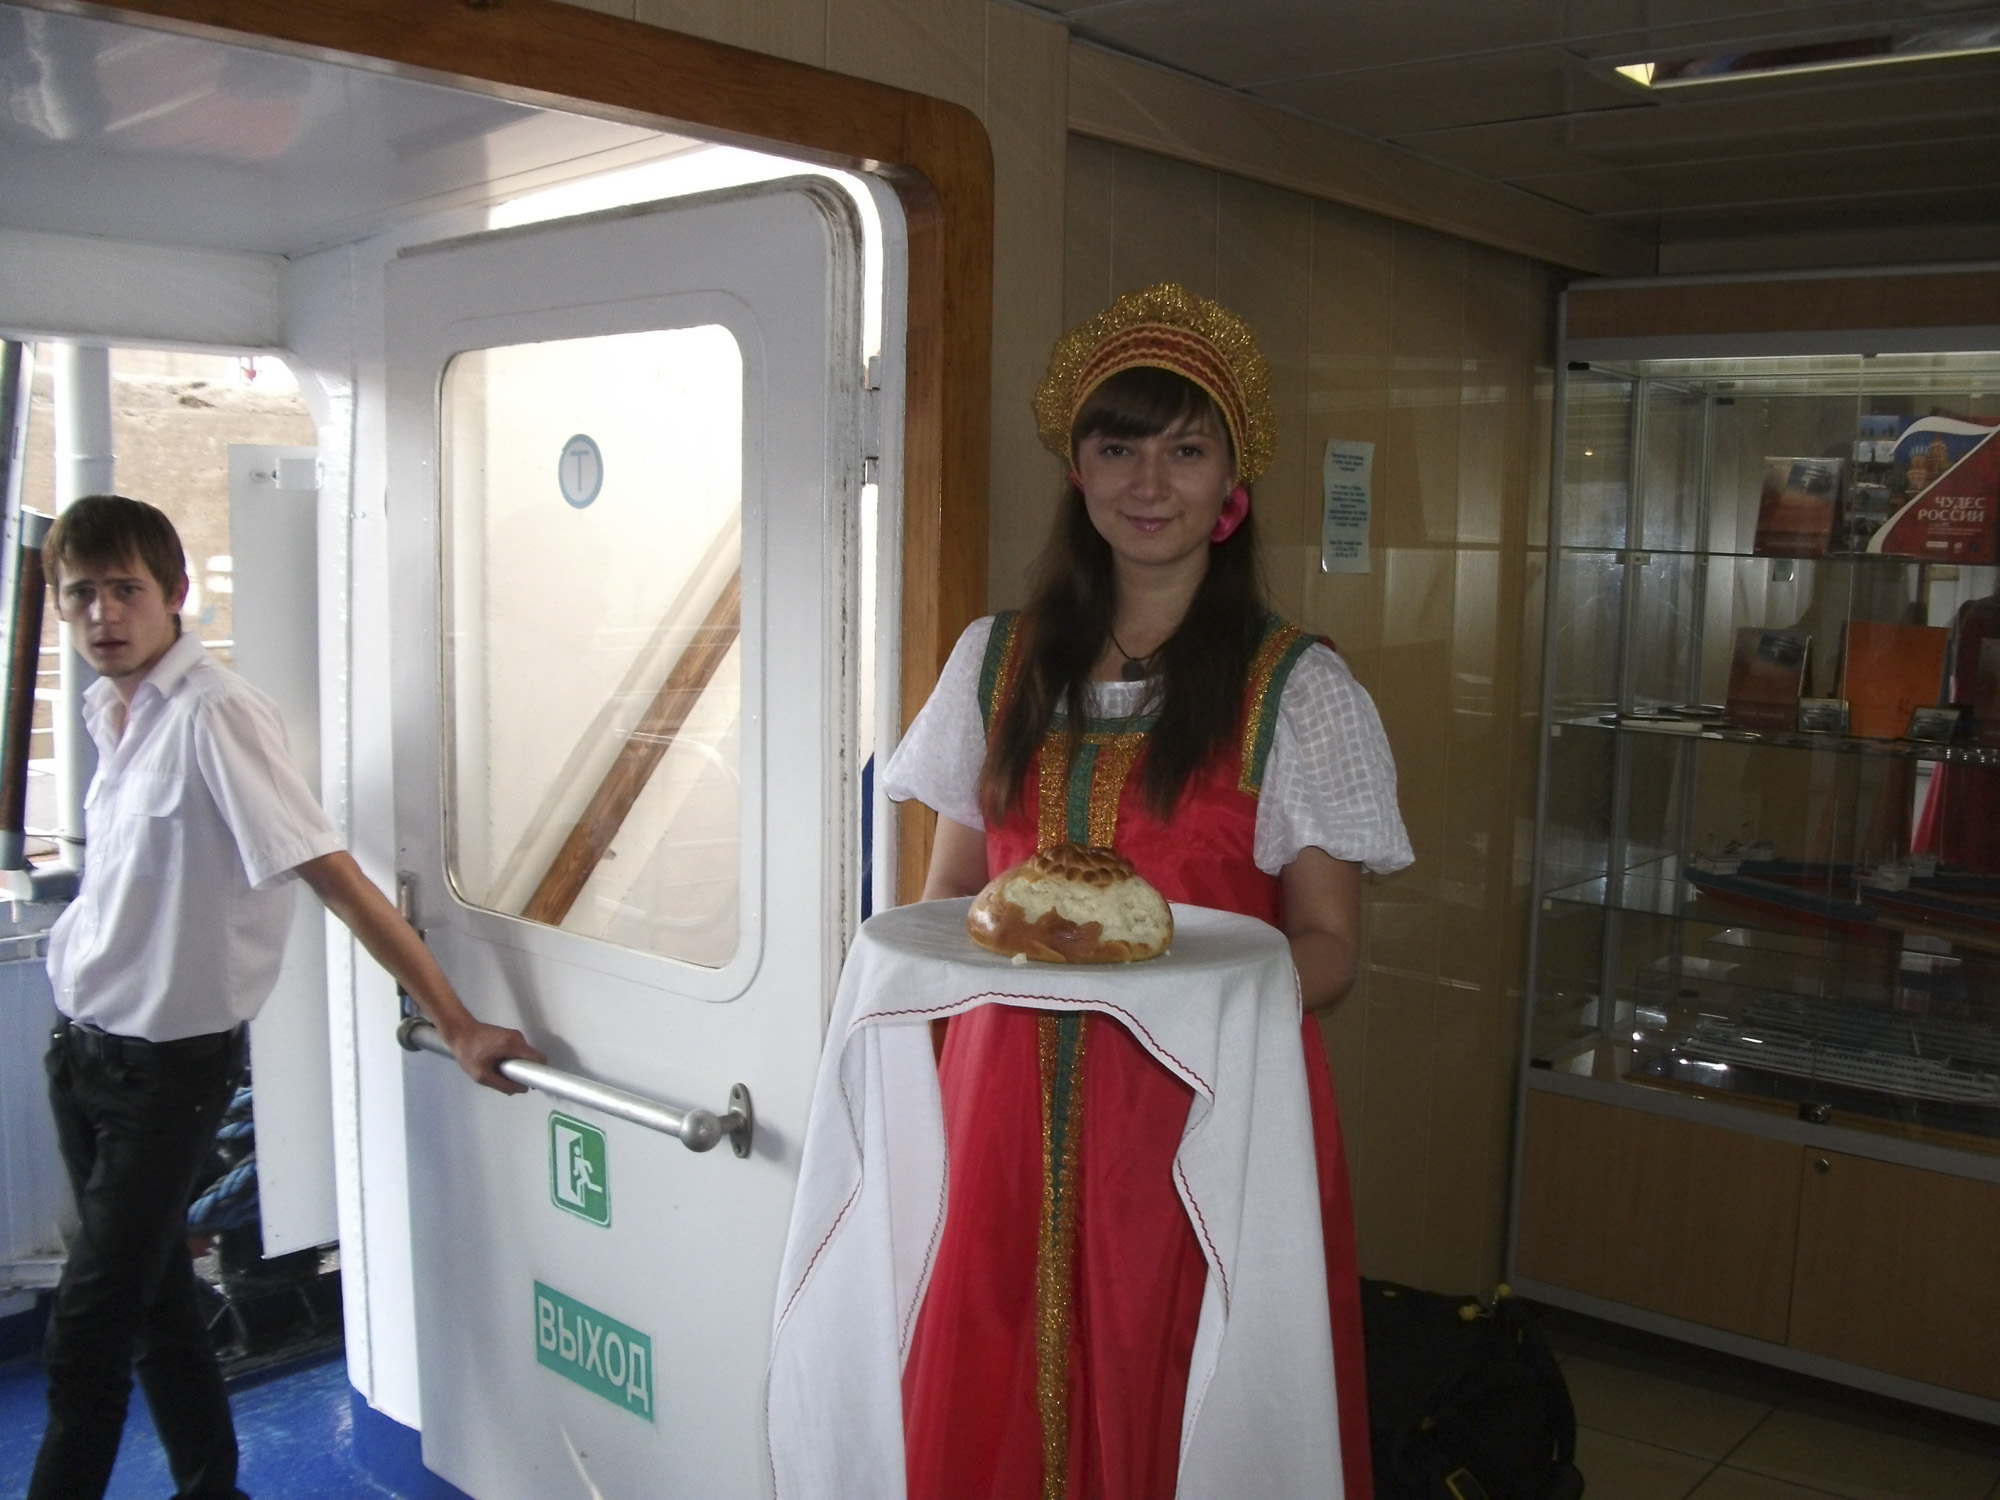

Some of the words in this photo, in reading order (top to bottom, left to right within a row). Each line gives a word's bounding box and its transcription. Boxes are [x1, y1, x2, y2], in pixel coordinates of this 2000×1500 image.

[1935, 496, 1986, 510] ЧУДЕС
[1918, 508, 1985, 522] РОССИИ
[537, 1295, 650, 1413] ВЫХОД
